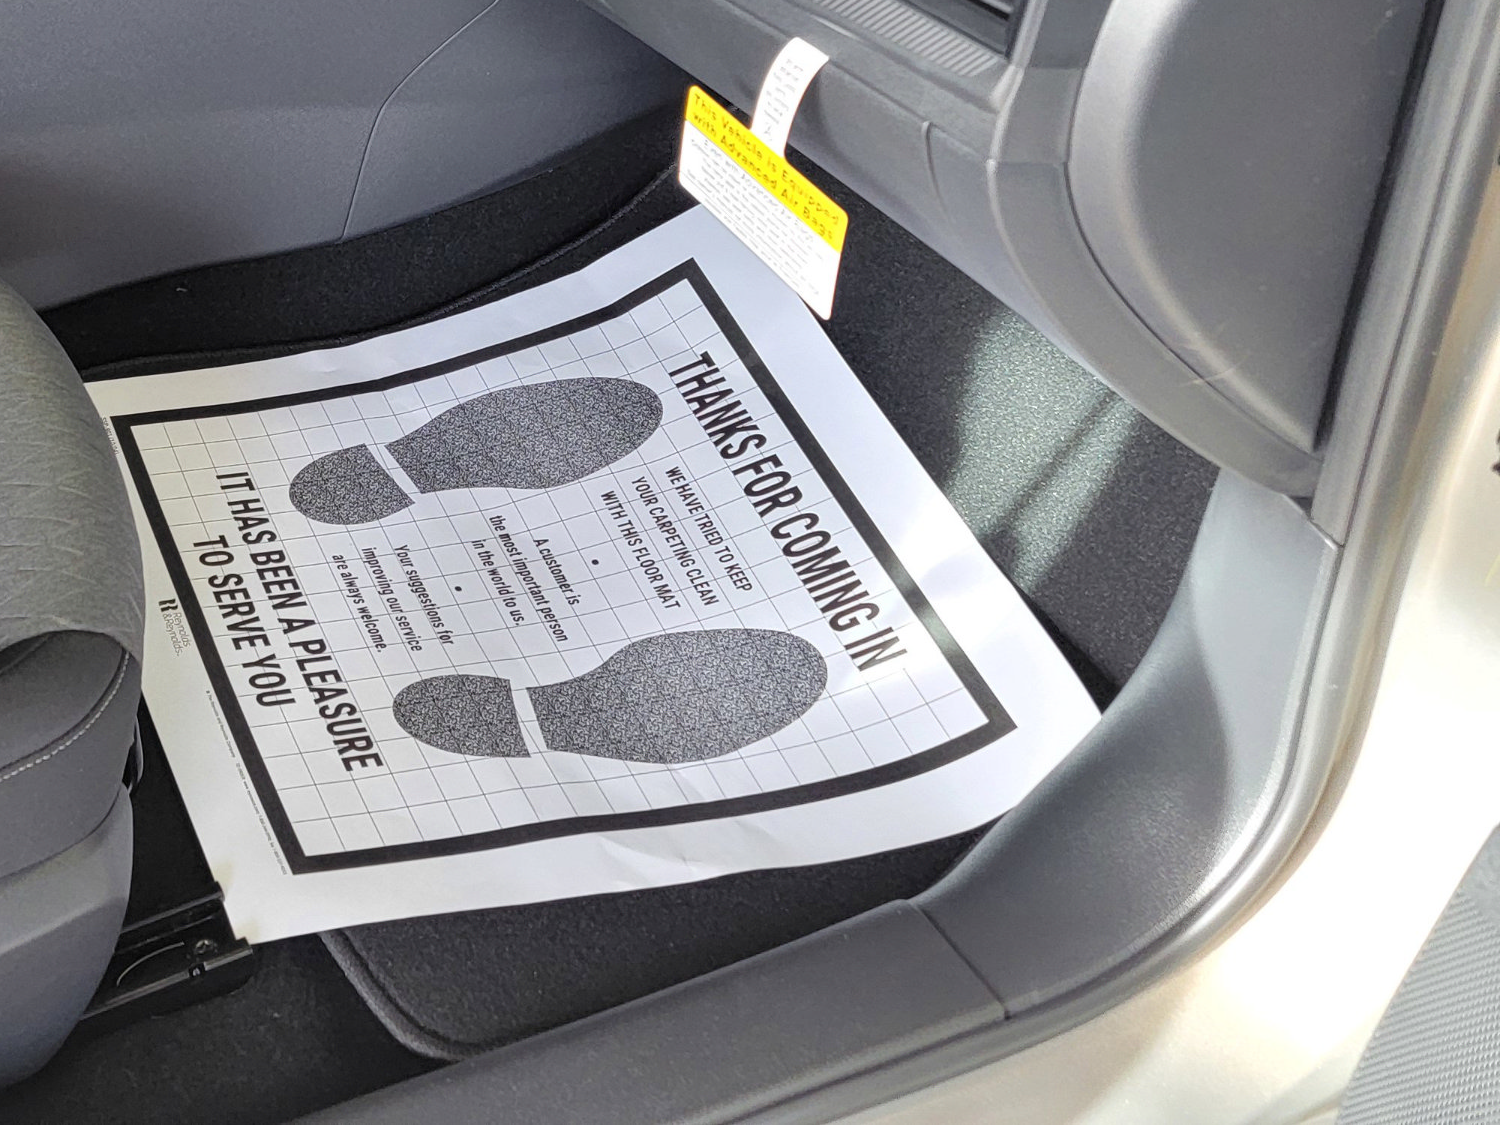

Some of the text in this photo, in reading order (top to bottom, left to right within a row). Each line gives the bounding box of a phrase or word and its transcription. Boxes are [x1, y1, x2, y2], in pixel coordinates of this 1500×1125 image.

[693, 112, 833, 239] with Advanced Air Bags
[695, 93, 716, 121] This
[722, 116, 762, 161] Vehicle
[782, 169, 839, 225] Equipped
[192, 534, 235, 567] TO
[601, 490, 681, 609] WITH THIS FLOOR MAT
[631, 476, 720, 606] YOUR CARPETING CLEAN
[665, 466, 753, 592] WE HAVE TRIED TO KEEP
[668, 350, 767, 460] THANKS
[732, 454, 803, 518] FOR
[770, 512, 880, 632] COMING
[844, 626, 908, 672] IN
[208, 573, 271, 650] SERVE
[216, 471, 384, 772] IT HAS BEEN A PLEASURE
[332, 554, 387, 653] are always welcome.
[361, 546, 422, 652] improving our service
[394, 544, 454, 646] Your suggestions for
[471, 539, 525, 626] in the world to us.
[489, 515, 569, 643] the most important person
[533, 537, 581, 605] A customer is
[173, 612, 191, 648] Reynolds
[241, 653, 297, 707] YOU
